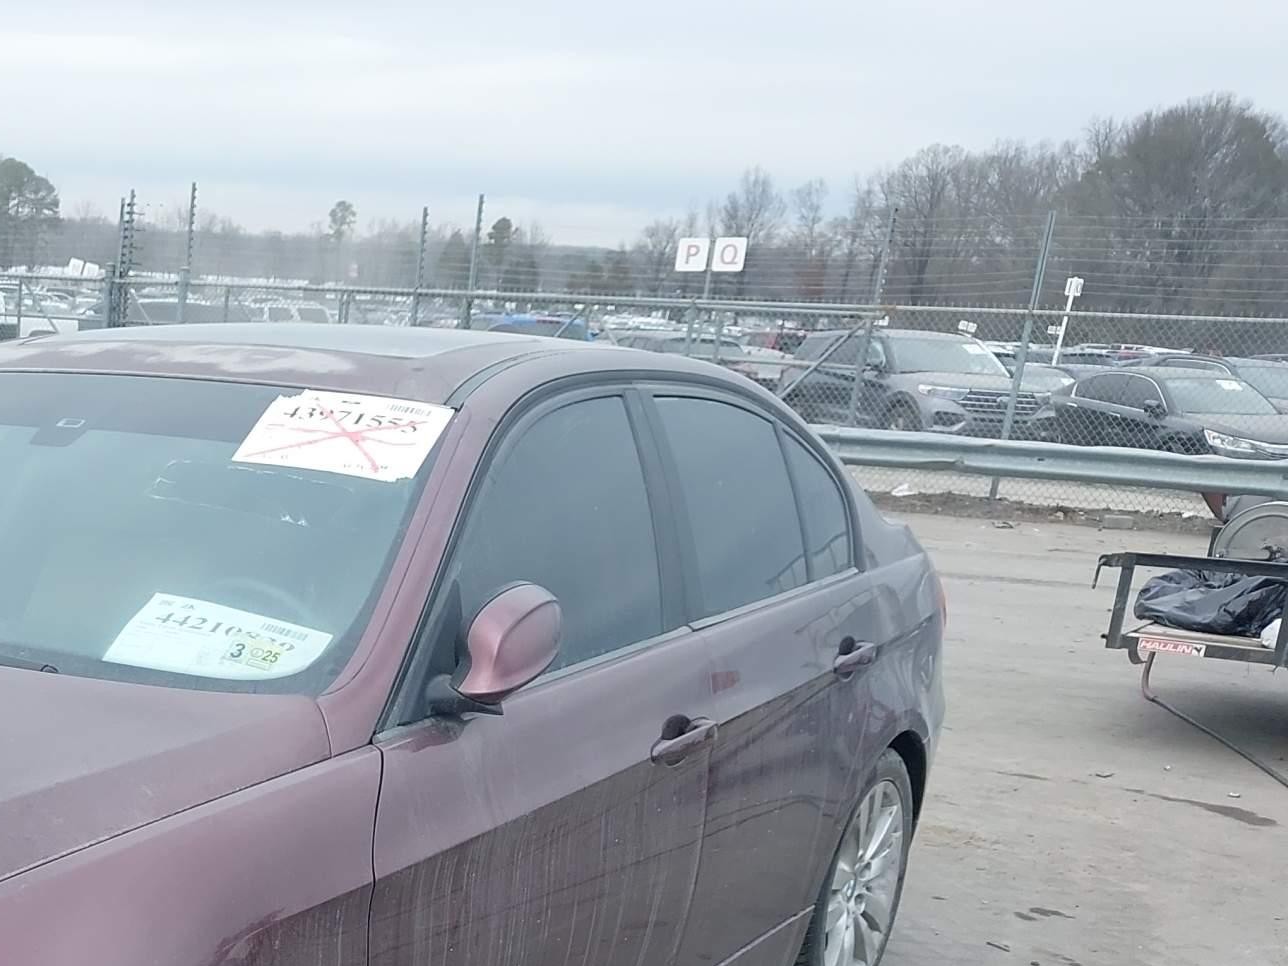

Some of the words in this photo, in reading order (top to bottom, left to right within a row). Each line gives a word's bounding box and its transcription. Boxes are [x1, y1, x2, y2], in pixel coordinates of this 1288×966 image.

[685, 244, 700, 264] P
[720, 243, 738, 264] Q
[229, 642, 246, 659] 3
[261, 649, 281, 664] 25
